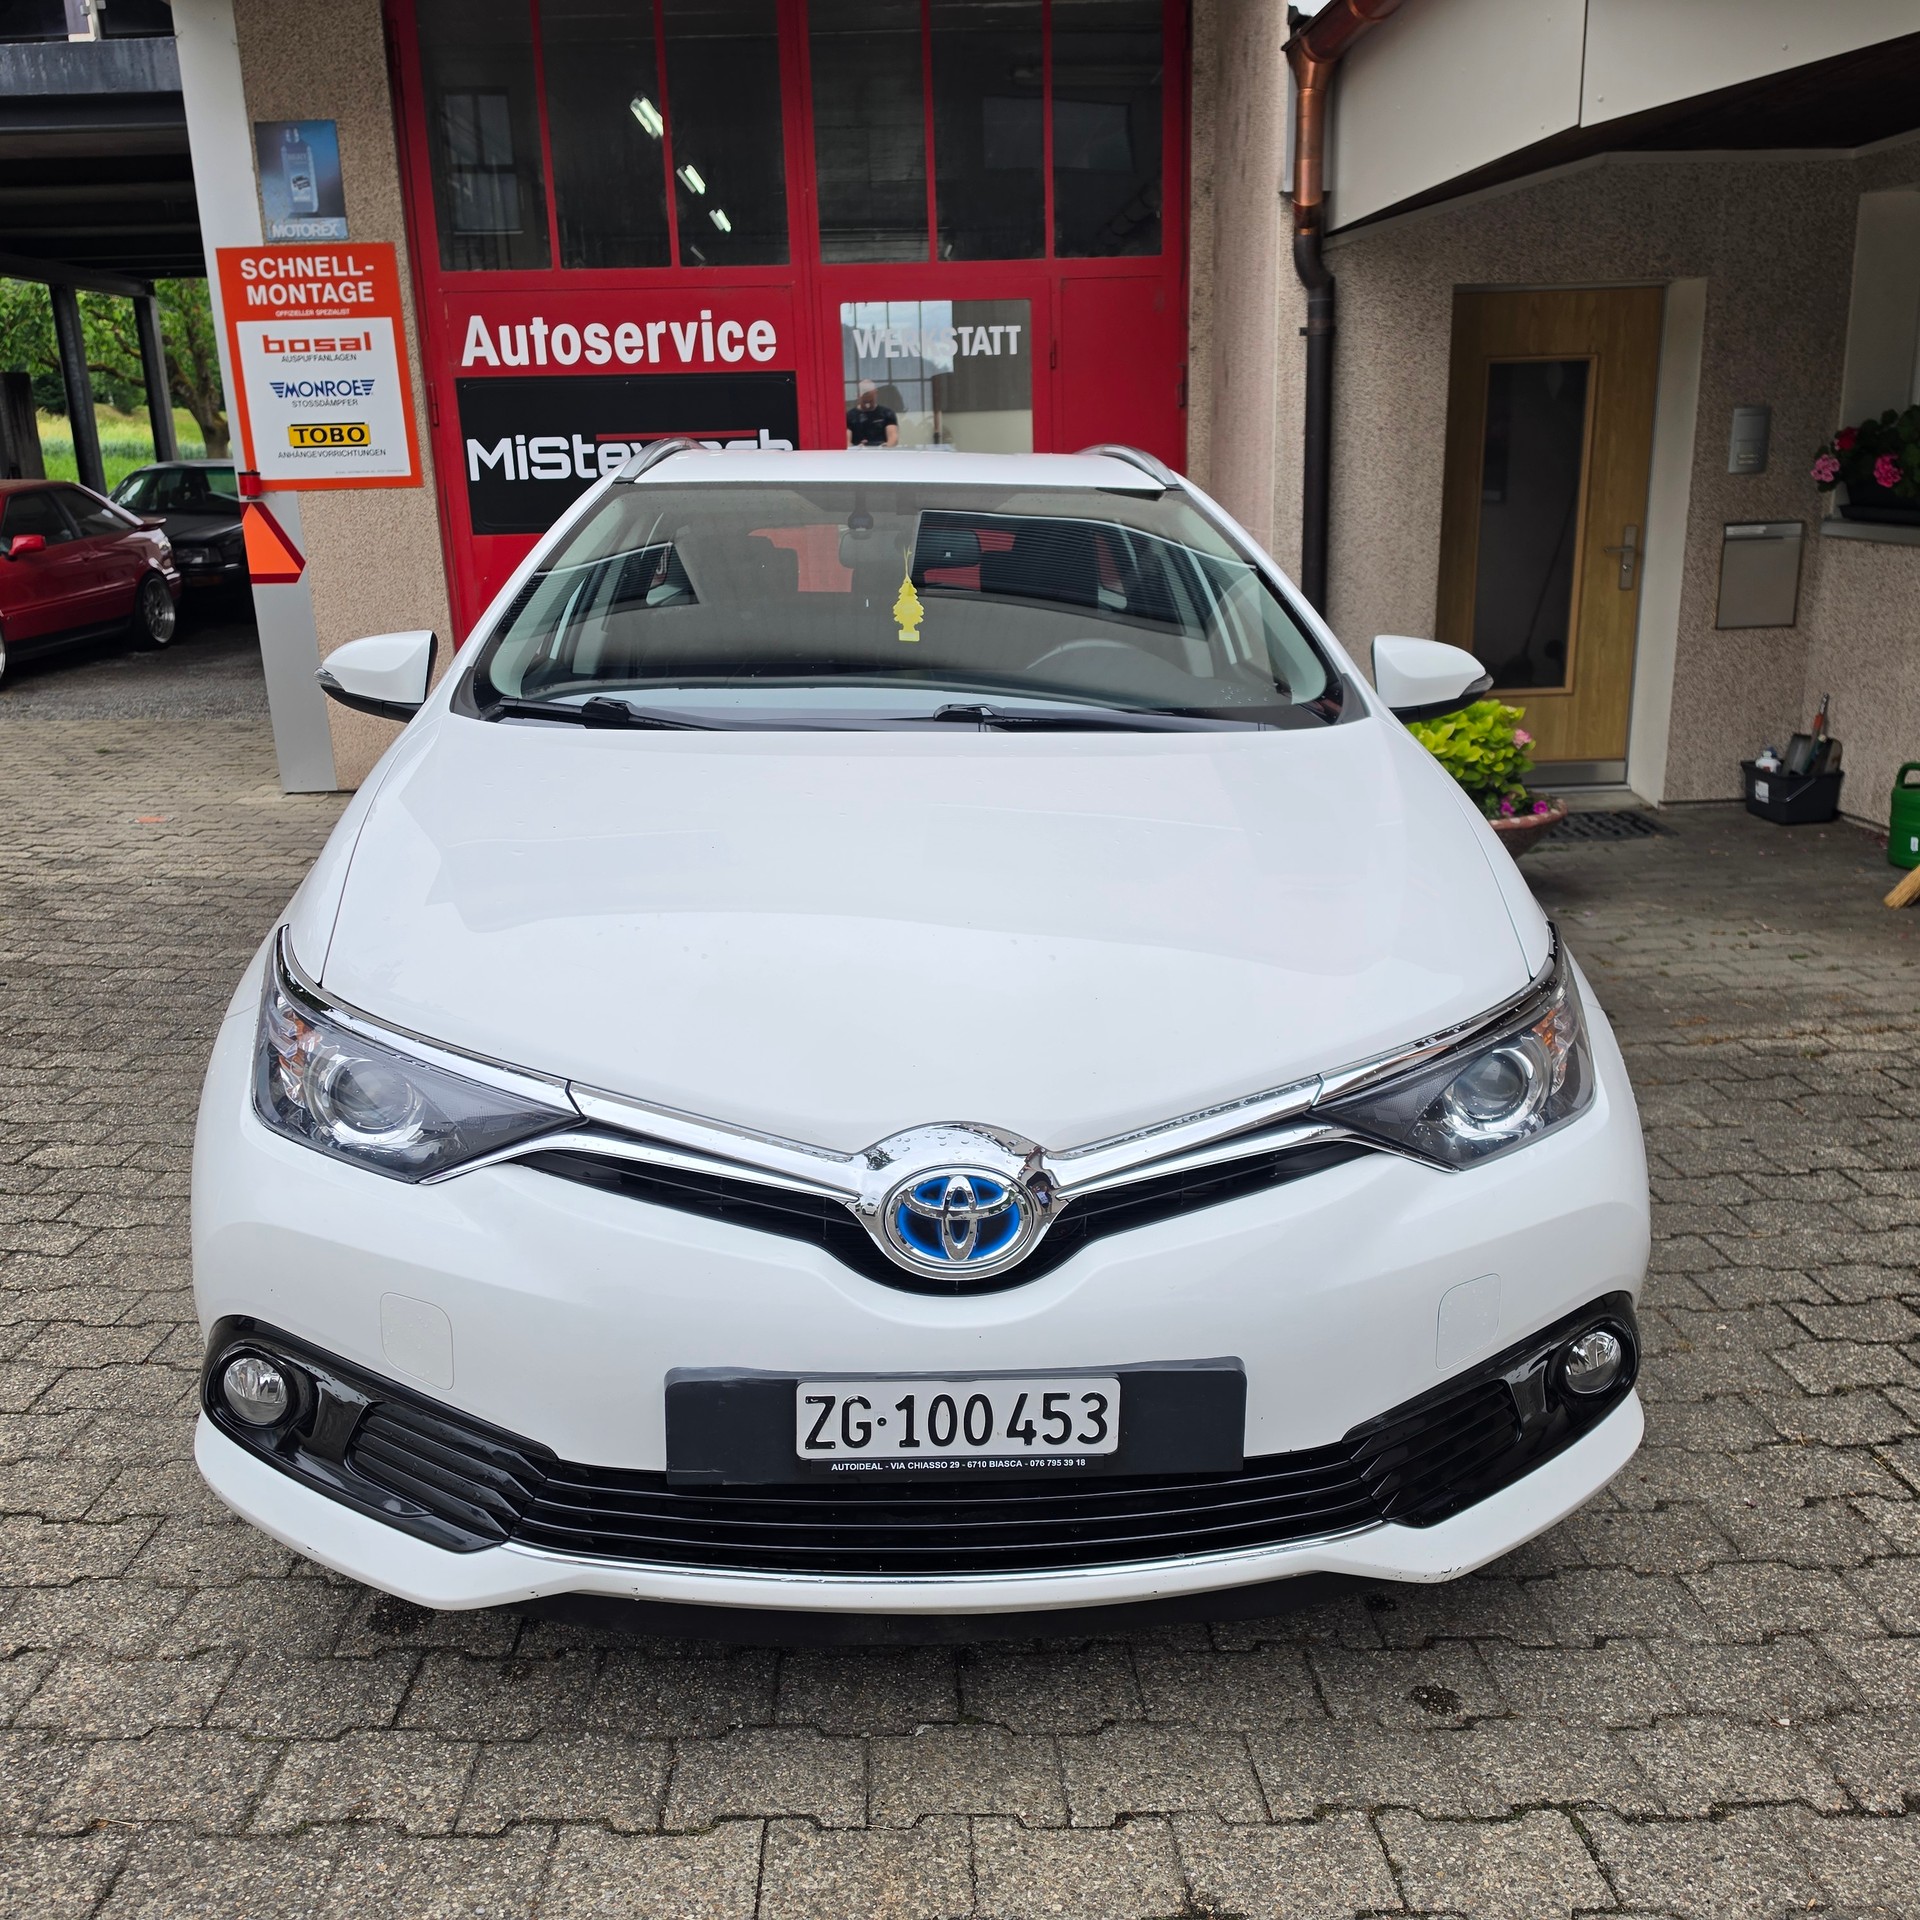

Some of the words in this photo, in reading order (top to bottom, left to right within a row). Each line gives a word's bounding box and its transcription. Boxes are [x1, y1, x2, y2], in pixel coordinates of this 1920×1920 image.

[271, 223, 339, 238] MOTOREX
[240, 256, 375, 280] SCHNELL-
[246, 281, 375, 306] MONTAGE
[262, 331, 372, 354] bosal
[461, 309, 777, 367] Autoservice
[852, 324, 1022, 359] WERKSTATT
[281, 353, 358, 363] AUSPUFFANLAGEN
[284, 380, 364, 398] MONROE
[293, 426, 366, 444] TOBO
[831, 1462, 883, 1471] AUTOIDEAL
[890, 1462, 906, 1470] VIA
[907, 1461, 947, 1470] CHIASSO
[949, 1461, 960, 1469] 29
[967, 1460, 987, 1469] 6710
[989, 1460, 1023, 1469] BIASCA
[1030, 1459, 1045, 1468] 076
[1047, 1459, 1062, 1468] 795
[1064, 1459, 1074, 1467] 39
[1076, 1459, 1086, 1467] 18
